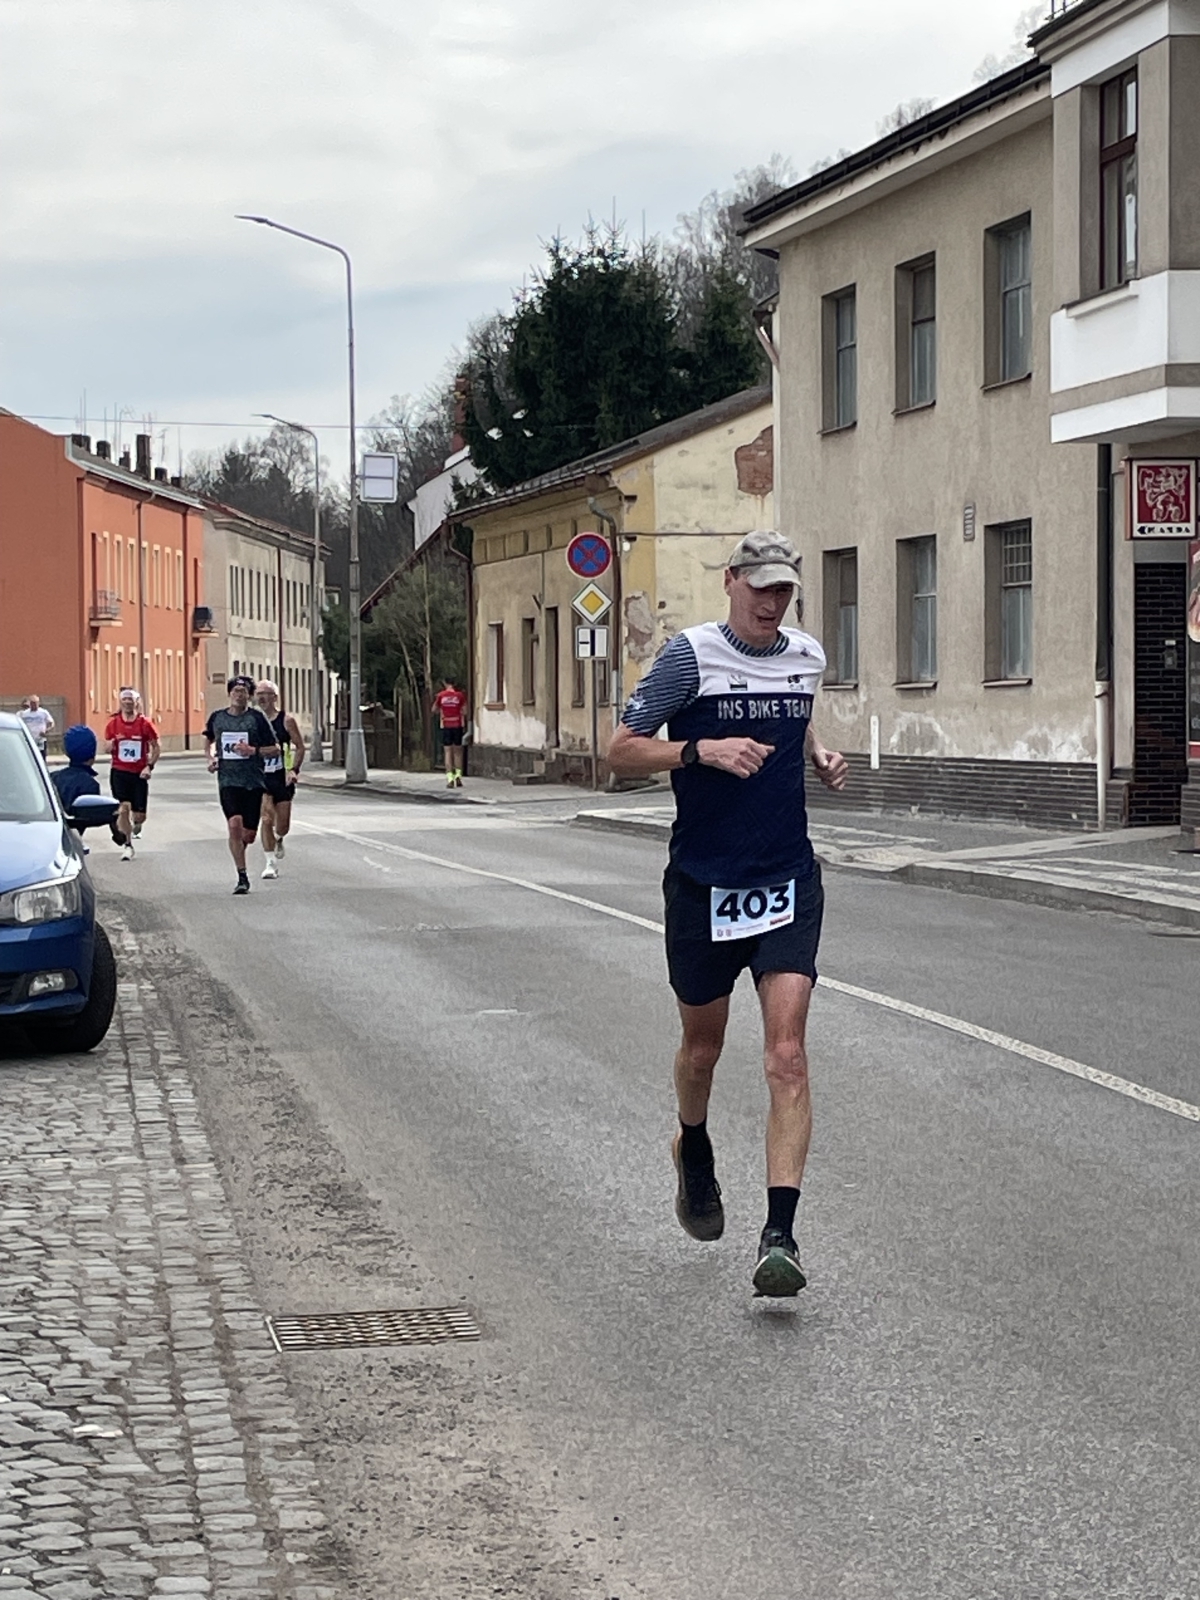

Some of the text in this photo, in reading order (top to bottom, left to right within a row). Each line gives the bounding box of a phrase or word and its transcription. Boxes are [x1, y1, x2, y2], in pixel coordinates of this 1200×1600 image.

[718, 699, 744, 720] INS
[748, 699, 780, 719] BIKE
[123, 748, 136, 757] 74
[716, 883, 790, 923] 403
